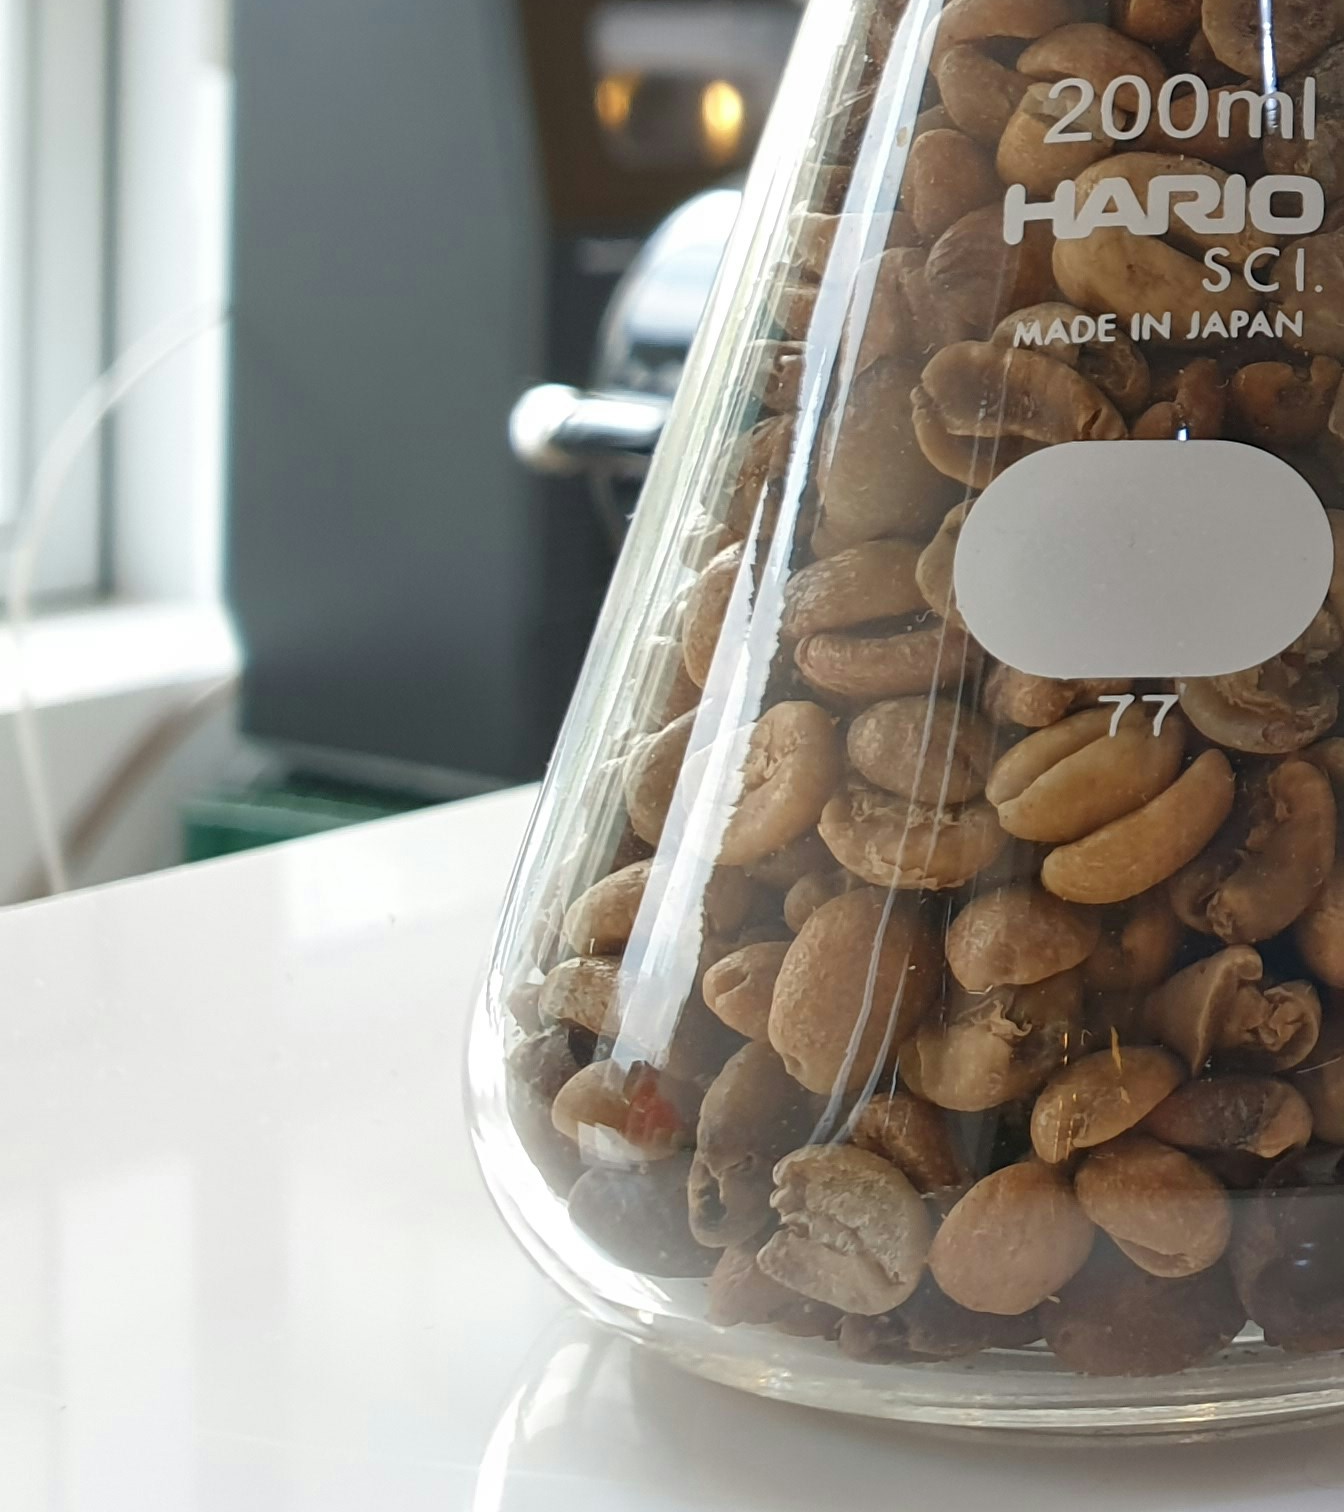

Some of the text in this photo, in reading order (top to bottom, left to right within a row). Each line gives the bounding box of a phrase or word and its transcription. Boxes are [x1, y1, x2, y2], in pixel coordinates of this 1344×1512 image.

[1043, 73, 1317, 144] 200ml
[1003, 174, 1325, 245] HARIO
[1202, 246, 1323, 292] SCI.
[1013, 310, 1303, 348] MADE IN JAPAN
[1097, 693, 1179, 737] 77
